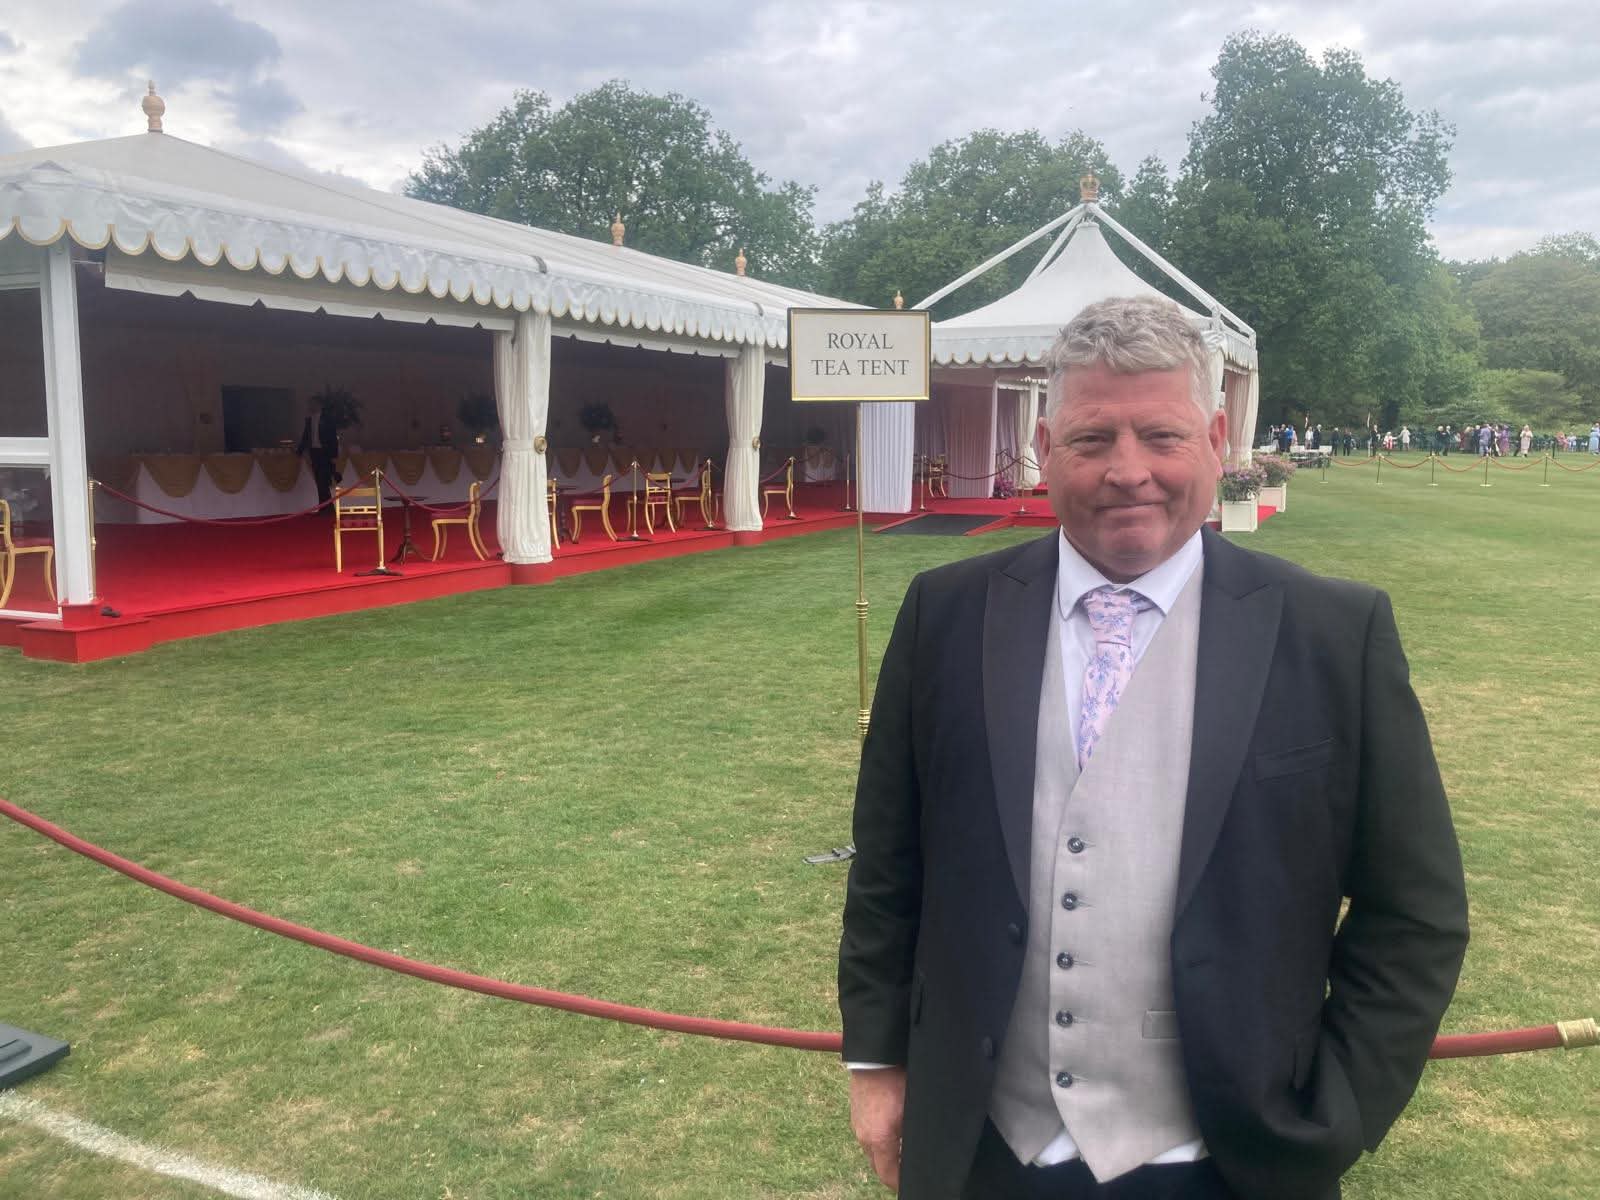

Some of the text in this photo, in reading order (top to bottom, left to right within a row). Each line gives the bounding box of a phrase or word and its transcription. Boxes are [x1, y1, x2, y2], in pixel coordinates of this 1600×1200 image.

[827, 332, 894, 350] ROYAL
[811, 359, 910, 376] TEA TENT
